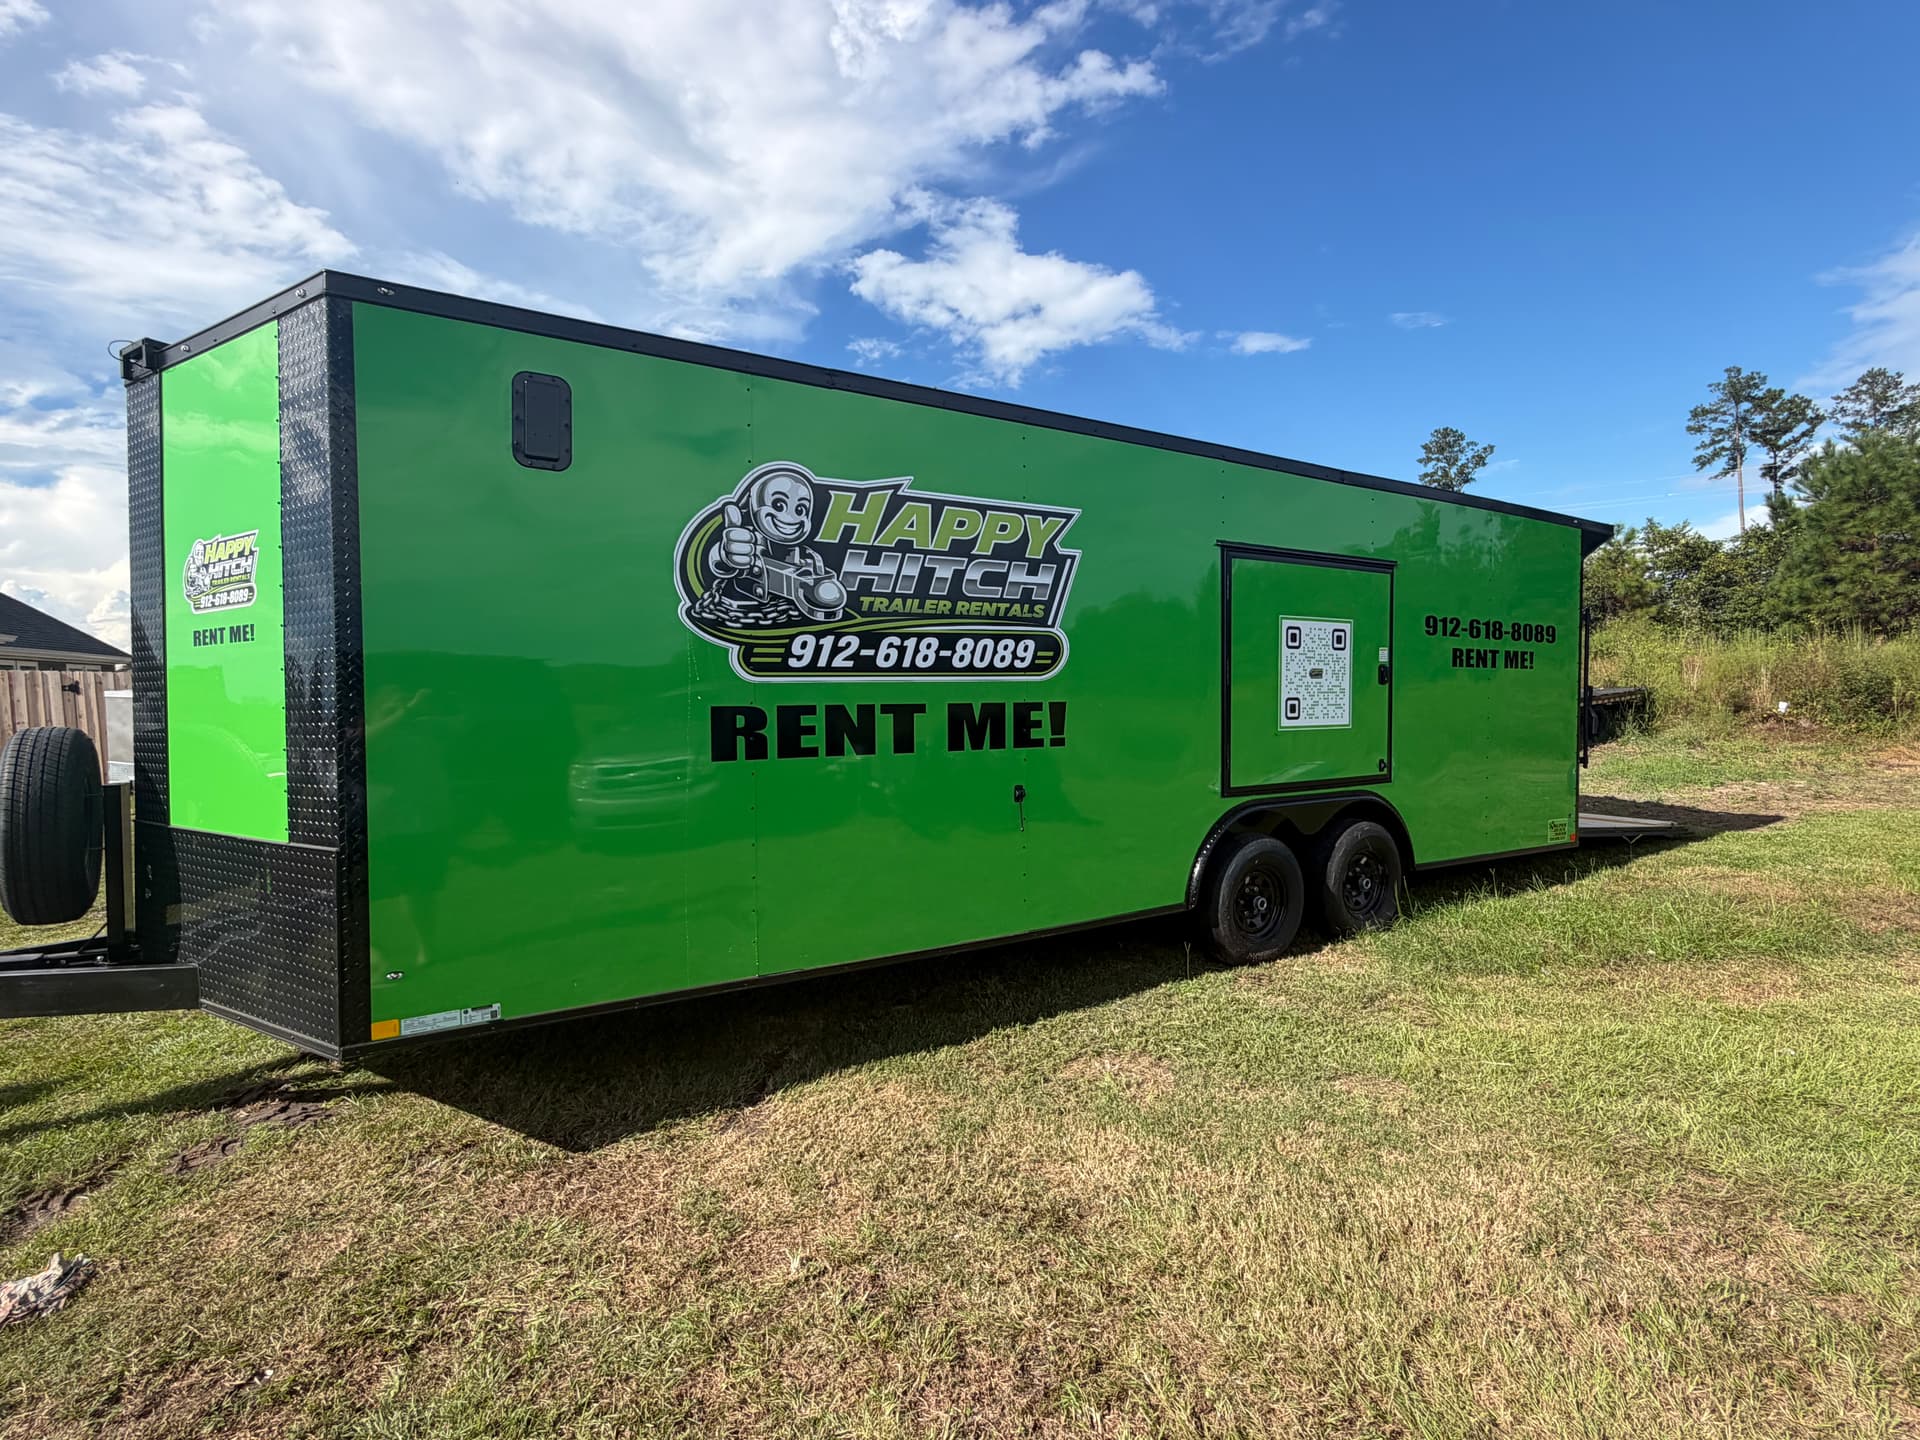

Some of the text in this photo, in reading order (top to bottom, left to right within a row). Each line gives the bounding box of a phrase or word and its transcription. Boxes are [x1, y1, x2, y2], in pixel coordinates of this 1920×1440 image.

[815, 489, 1066, 558] HAPPY
[204, 535, 254, 564] HAPPY
[208, 556, 253, 579] HITCH
[842, 549, 1057, 600] HITCH
[200, 589, 249, 608] 912-618-8089
[859, 596, 1045, 618] TRAILER RENTALS
[193, 624, 255, 647] RENT ME!
[1425, 615, 1556, 644] 912-618-8089
[787, 634, 1034, 669] 912-618-8089
[1452, 648, 1534, 669] RENT ME!
[710, 701, 1068, 763] RENT ME!
